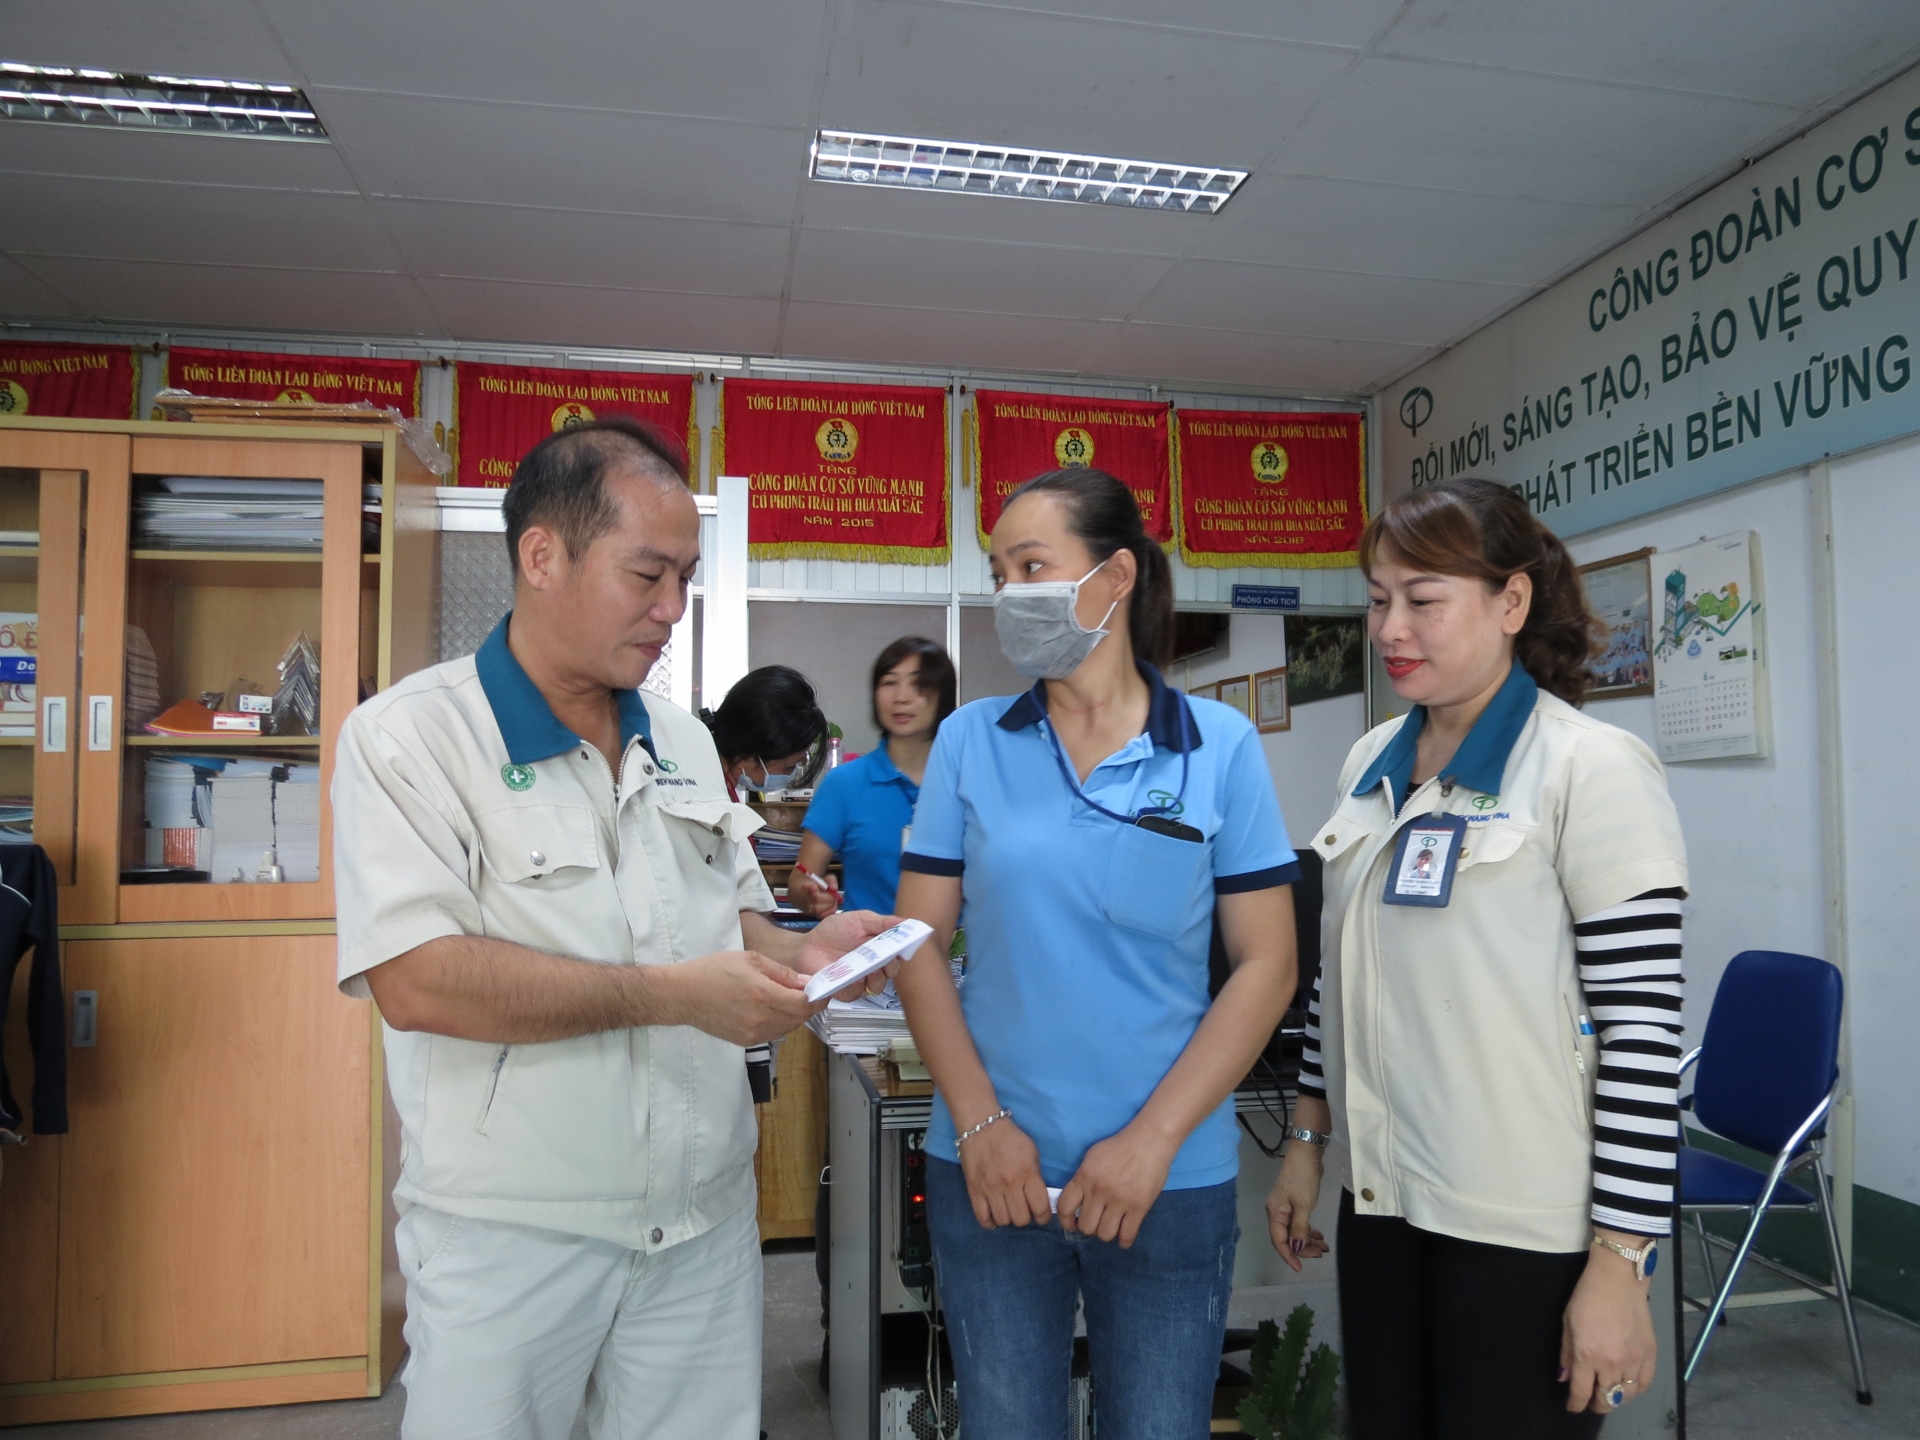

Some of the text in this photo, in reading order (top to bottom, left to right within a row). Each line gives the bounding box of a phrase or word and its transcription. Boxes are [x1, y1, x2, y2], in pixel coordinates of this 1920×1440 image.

[1589, 248, 1680, 333] CÔNG
[1689, 175, 1802, 281] ĐOÀN
[1816, 125, 1889, 211] CƠ
[1, 359, 17, 373] AO
[82, 354, 108, 369] NAM
[1411, 217, 1919, 488] ĐỔI MỚI, SÁNG TẠO, BẢO VỆ QUY
[182, 363, 403, 396] TỔNG LIÊN ĐOÀN LAO ĐỘNG VIỆT NAM
[479, 375, 670, 405] TỔNG LIÊN ĐOÀN LAO ĐỘNG VIỆT NAM
[747, 393, 925, 418] TỔNG LIÊN ĐOÀN LAO ĐỘNG VIỆT NAM
[994, 403, 1019, 418] TỔNG
[1020, 405, 1041, 420] LIÊN
[1043, 407, 1067, 423] ĐOÀN
[1068, 410, 1086, 424] LAO
[1113, 411, 1135, 427] VIỆT
[1136, 414, 1156, 428] NAM
[1584, 422, 1674, 496] TRIỂN
[1686, 389, 1761, 461] BỀN
[1774, 334, 1911, 428] VỮNG
[1235, 421, 1259, 438] ĐOÀN
[1261, 425, 1279, 438] LAO
[1328, 425, 1348, 438] NAM
[750, 471, 924, 498] CÔNG ĐOÀN CƠ SỞ VỮNG MẠNH
[752, 492, 923, 514] CÓ PHONG TRÀO THI ĐUA XUẤT SẮC
[1195, 497, 1222, 514] CÔNG
[1224, 497, 1253, 515] ĐOÀN
[1255, 500, 1269, 515] CƠ
[1271, 497, 1286, 515] SỞ
[1317, 499, 1348, 517] MẠNH
[841, 518, 874, 527] 2015
[1216, 519, 1244, 531] PHONG
[1270, 519, 1283, 531] THI
[1326, 516, 1345, 531] SẮC
[1236, 594, 1296, 606] PHÒNG CHỦ TỊCH
